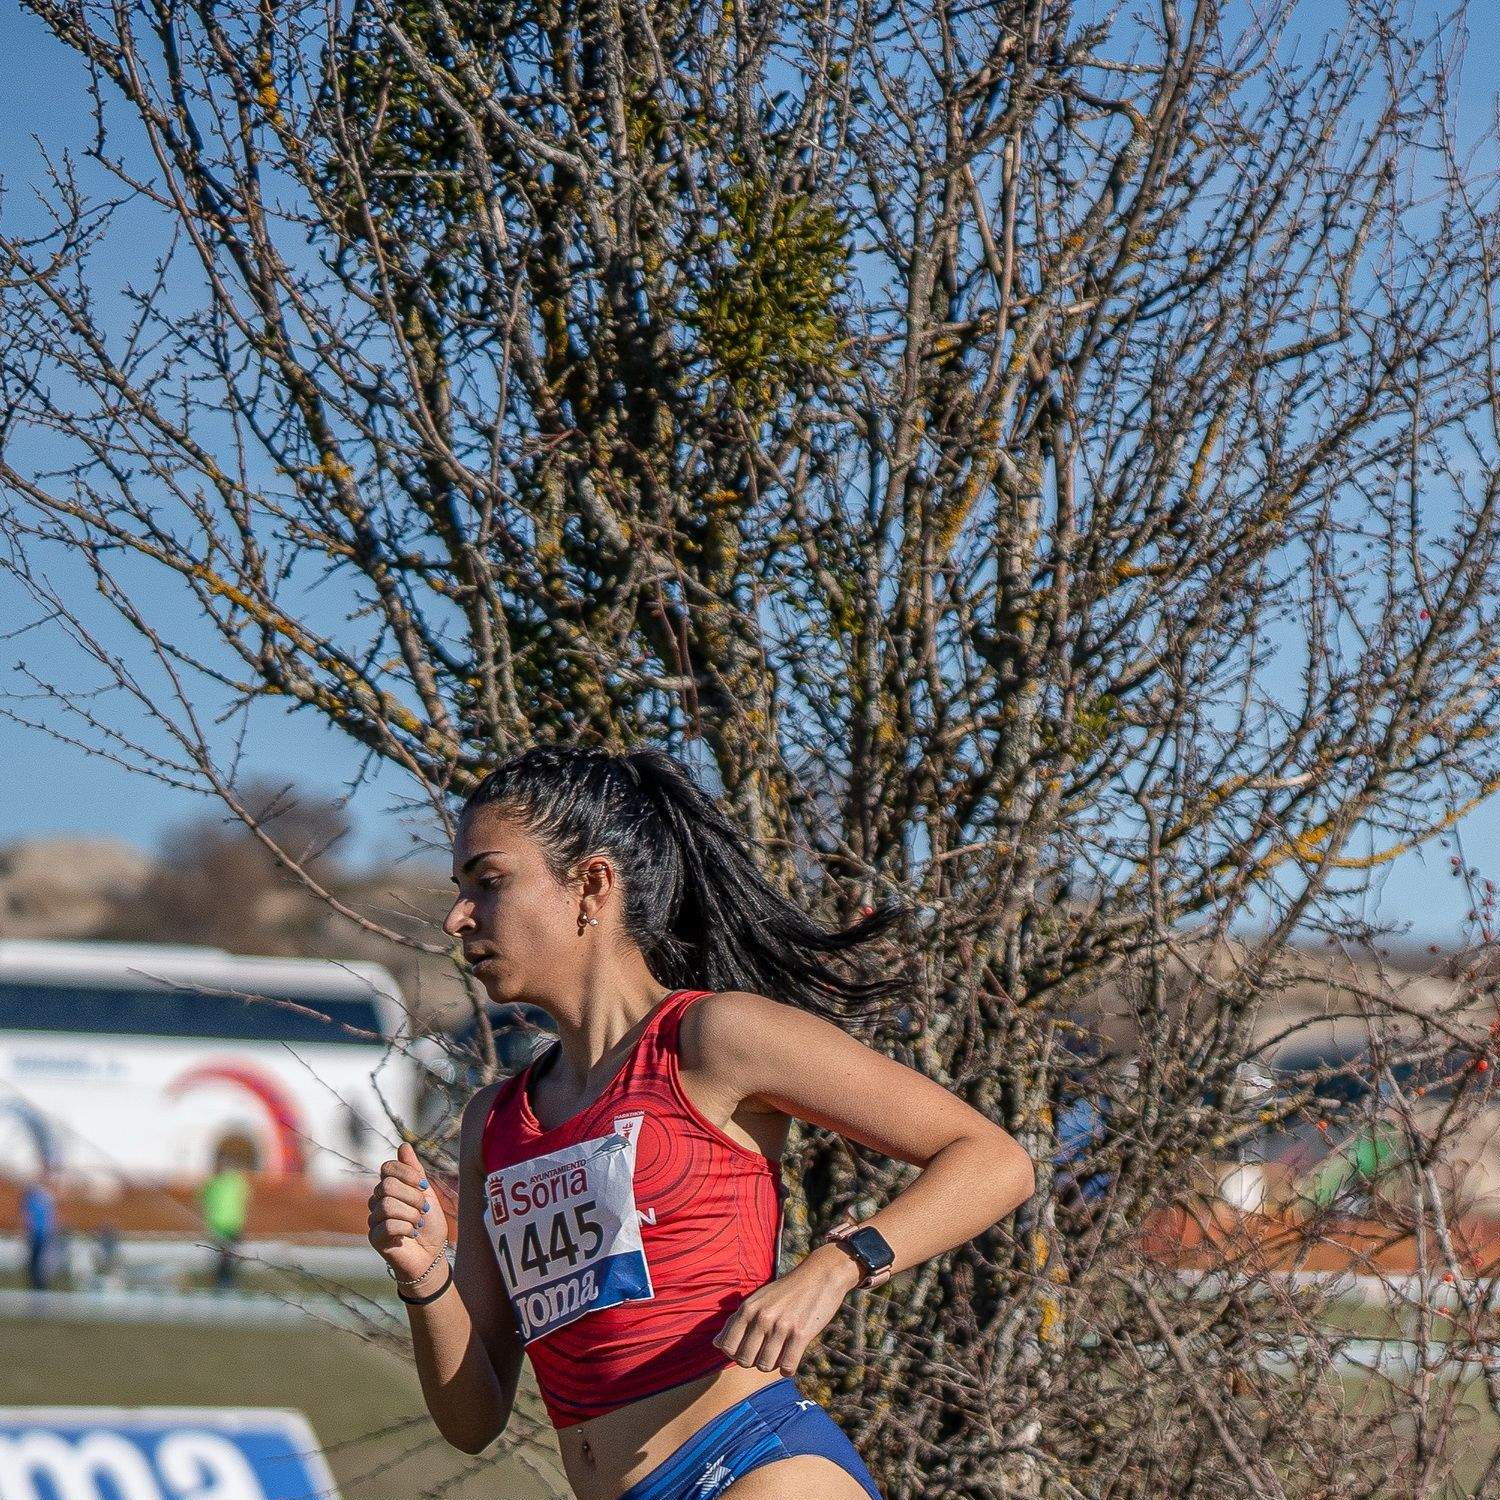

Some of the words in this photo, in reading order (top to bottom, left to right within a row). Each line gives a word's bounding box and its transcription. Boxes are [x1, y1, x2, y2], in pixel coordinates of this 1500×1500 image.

[511, 1168, 588, 1216] Soria
[529, 1159, 588, 1184] AYUNTAMIENTO
[498, 1200, 604, 1289] 1445
